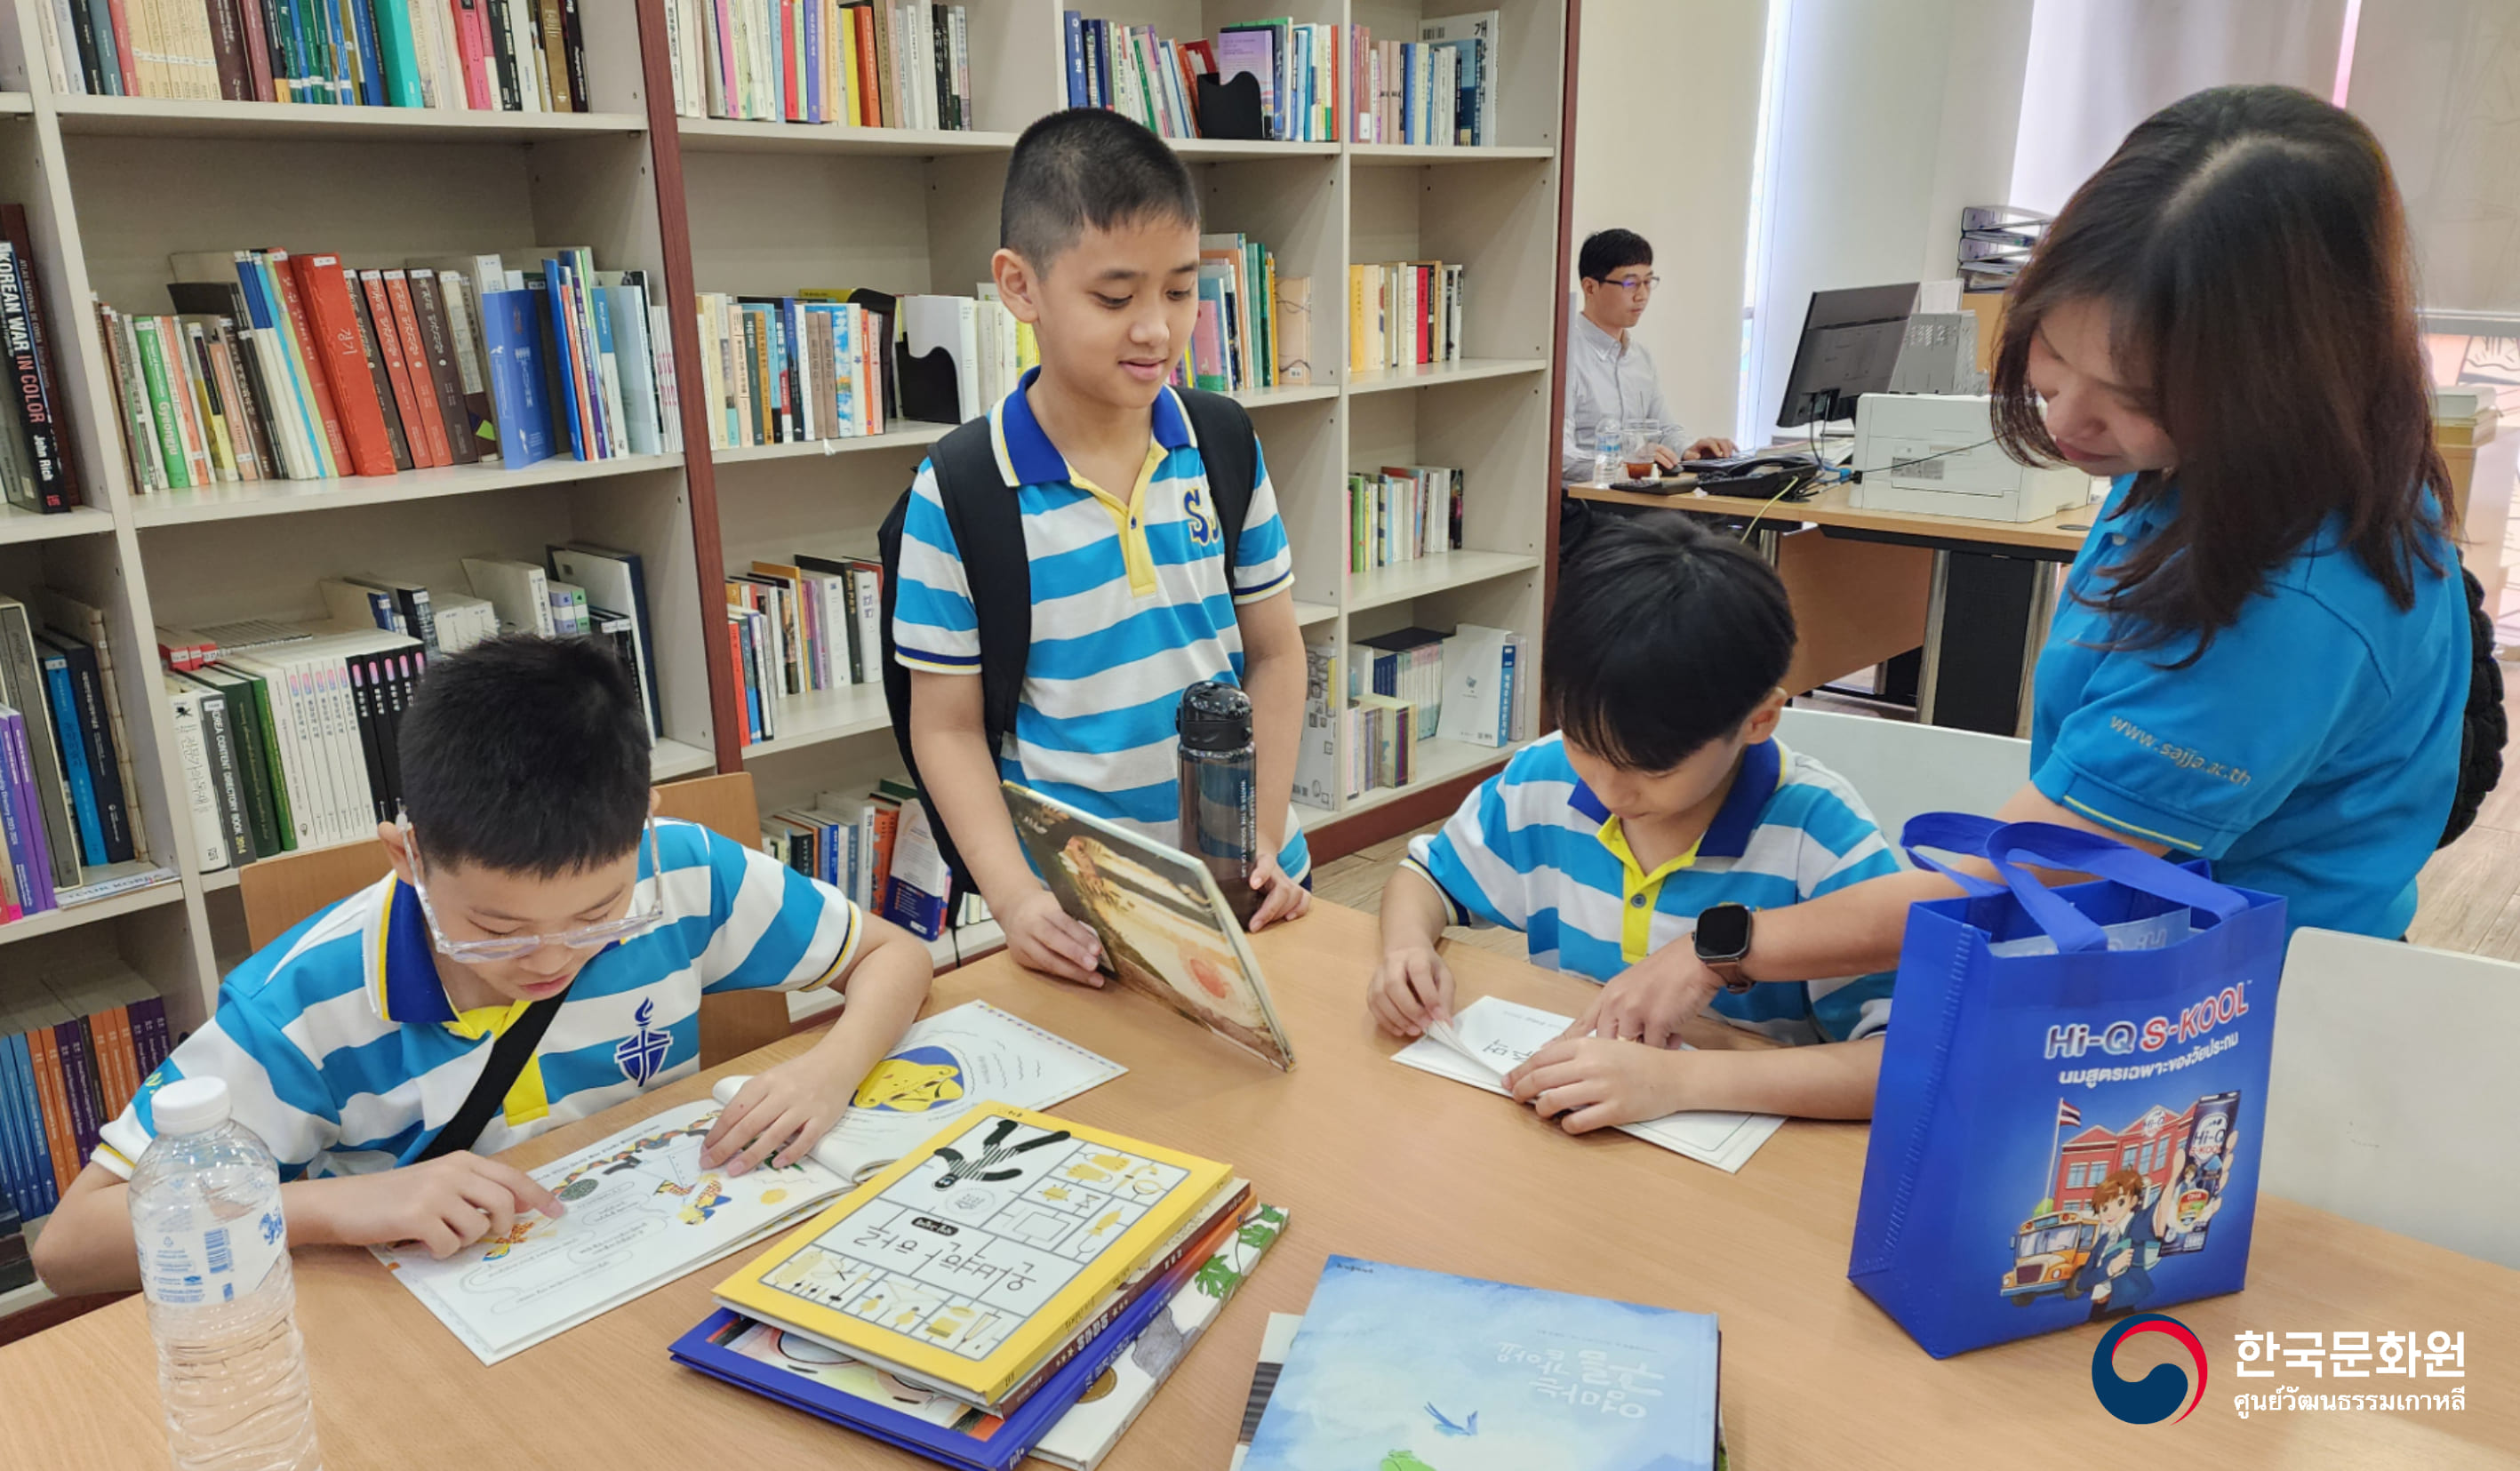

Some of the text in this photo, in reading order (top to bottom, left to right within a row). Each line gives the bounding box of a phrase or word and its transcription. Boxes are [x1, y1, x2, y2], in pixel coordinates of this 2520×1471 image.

[0, 251, 45, 424] KOREAN WAR IN COLOR
[337, 327, 358, 356] 경기
[158, 402, 179, 456] Gyeongju
[33, 434, 53, 482] John Rich
[216, 734, 231, 771] CONTENT
[2110, 715, 2252, 787] www.sajja.ac.th
[223, 771, 239, 811] DIRECTORY
[231, 813, 243, 835] BOOK
[235, 835, 246, 855] 2014
[2044, 981, 2250, 1060] Hi-Q S-KOOL
[2059, 1033, 2239, 1089] นมสูตรเฉพาะของวัยประถม
[1497, 1342, 1665, 1395] 구름 같아요
[1570, 1379, 1647, 1419] 엄마는
